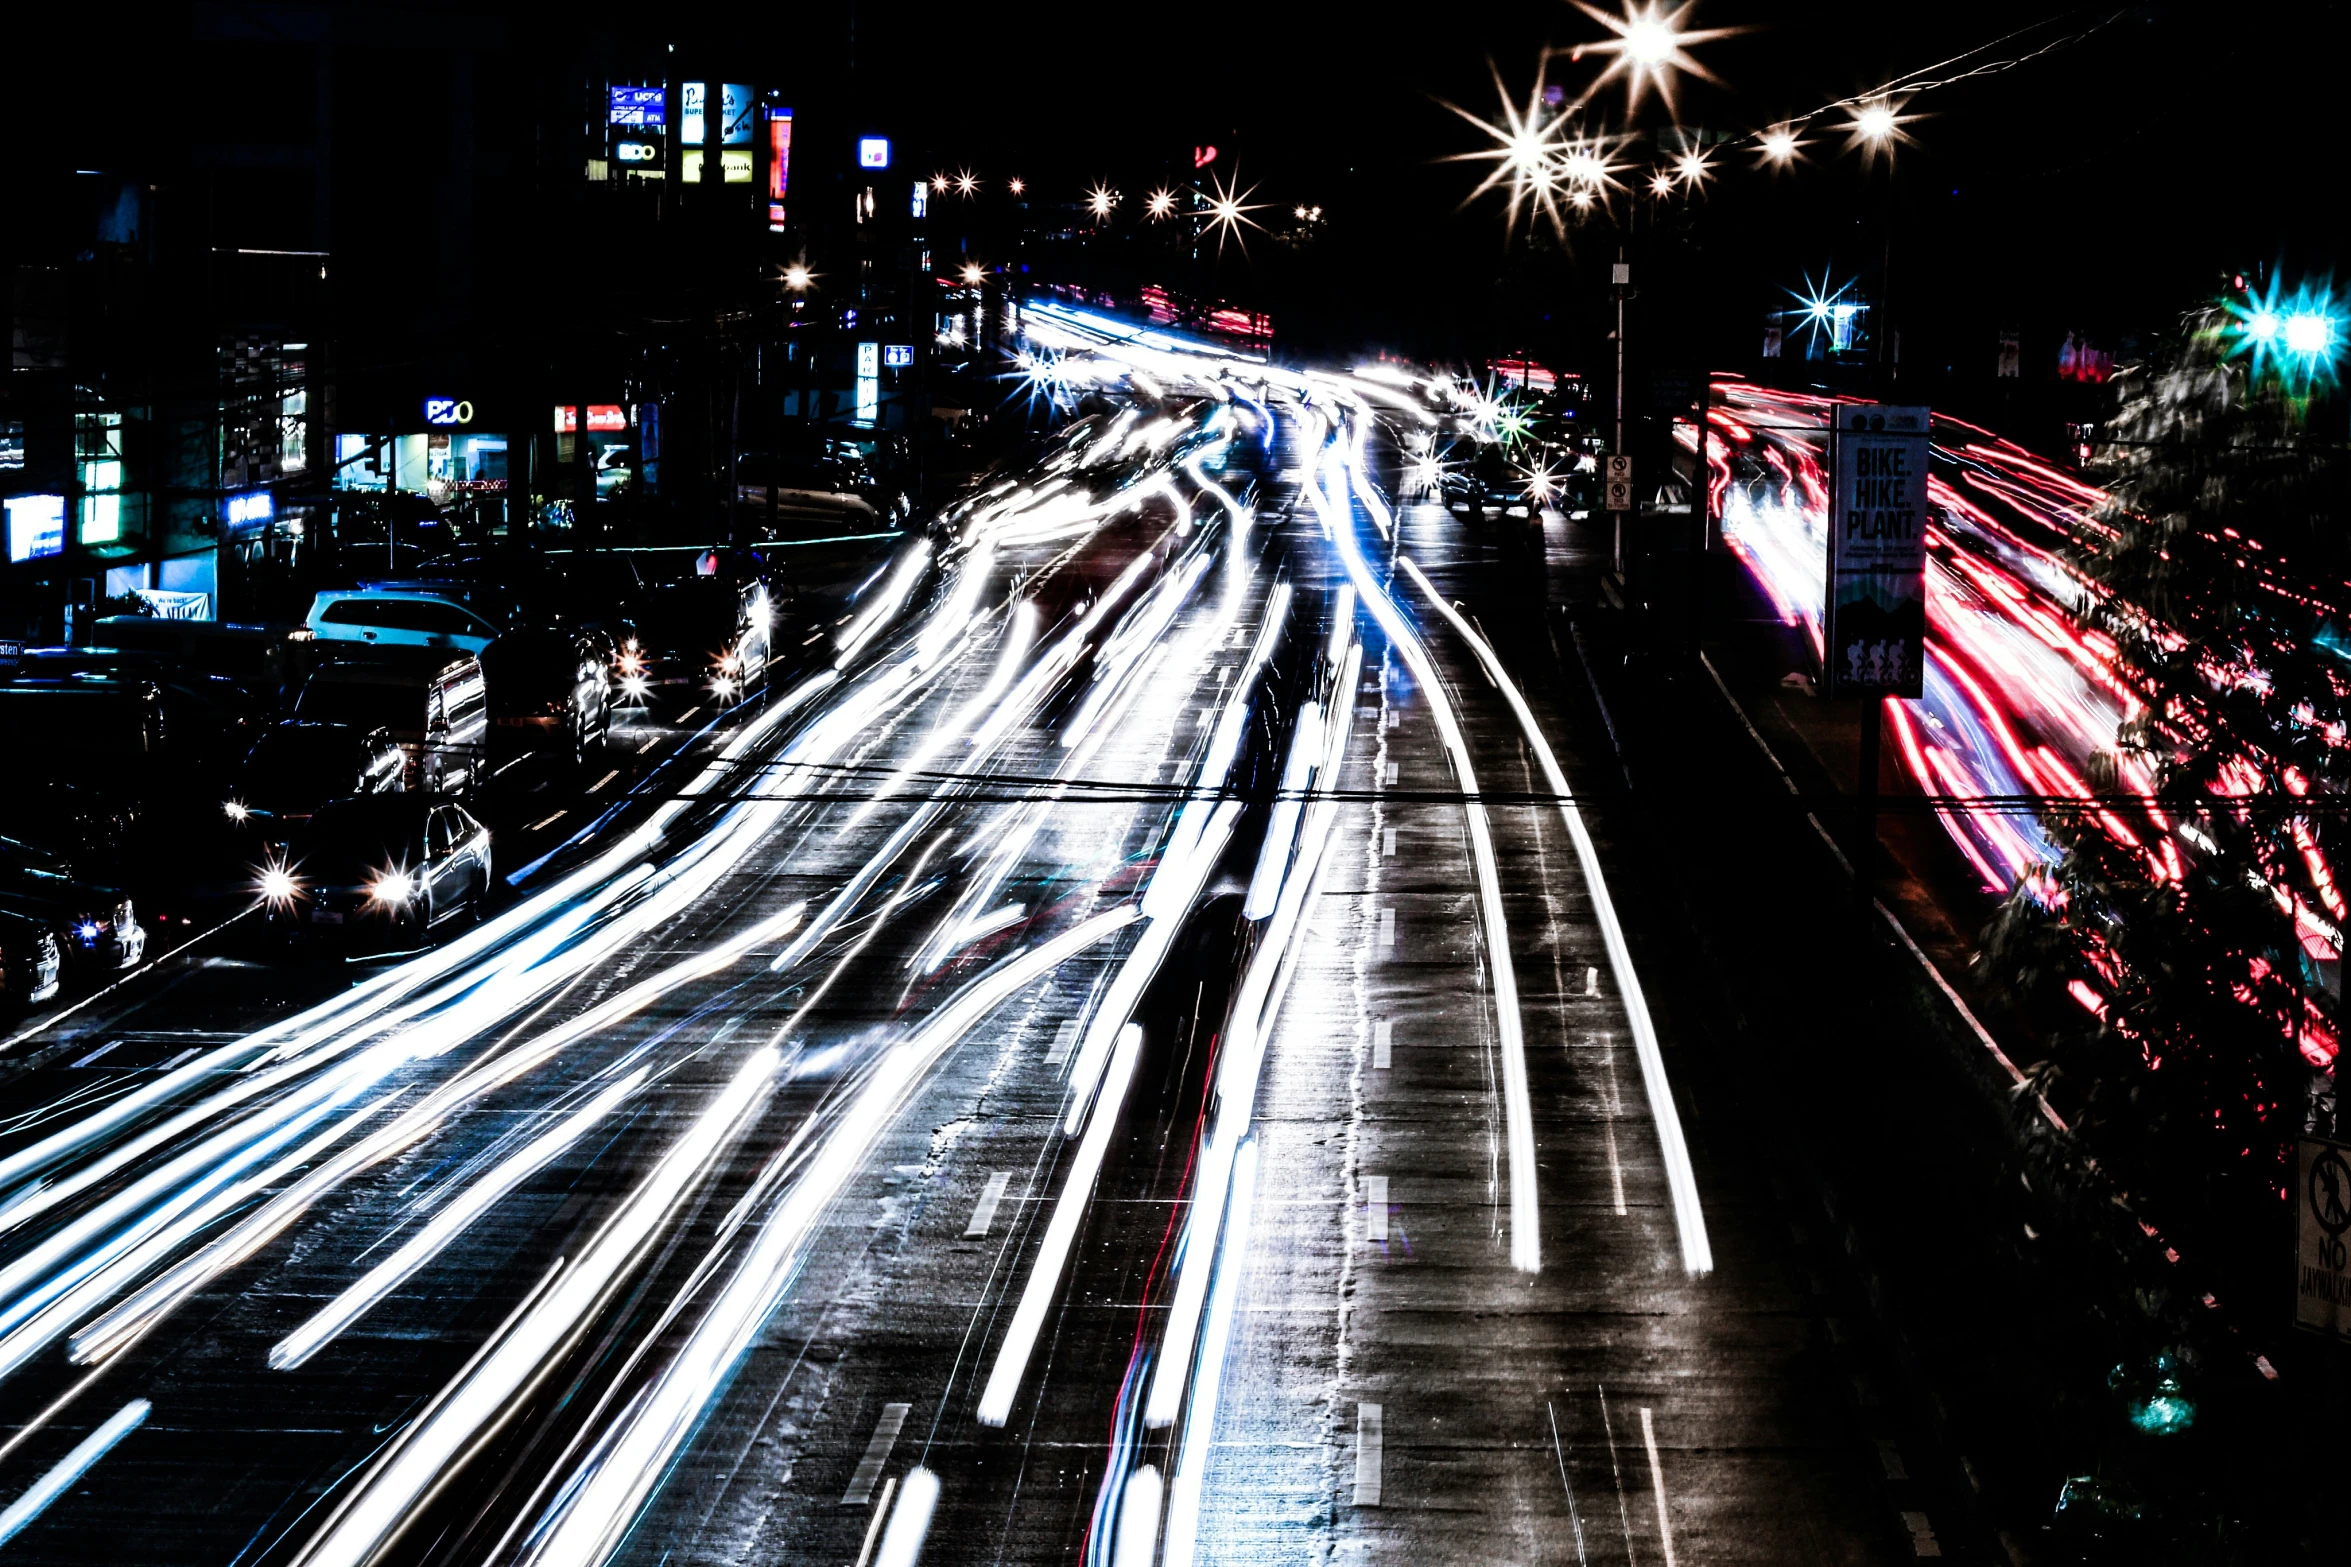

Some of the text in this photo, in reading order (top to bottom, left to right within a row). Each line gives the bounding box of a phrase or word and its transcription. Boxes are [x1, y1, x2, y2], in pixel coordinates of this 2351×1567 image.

[619, 144, 656, 161] BDO
[1857, 447, 1912, 477] BIKE.
[1856, 479, 1912, 508] HIKE.
[1847, 510, 1918, 540] PLANT.
[0, 643, 25, 656] sten's
[2319, 1236, 2347, 1271] NO
[2301, 1266, 2351, 1308] JAYWALKI
